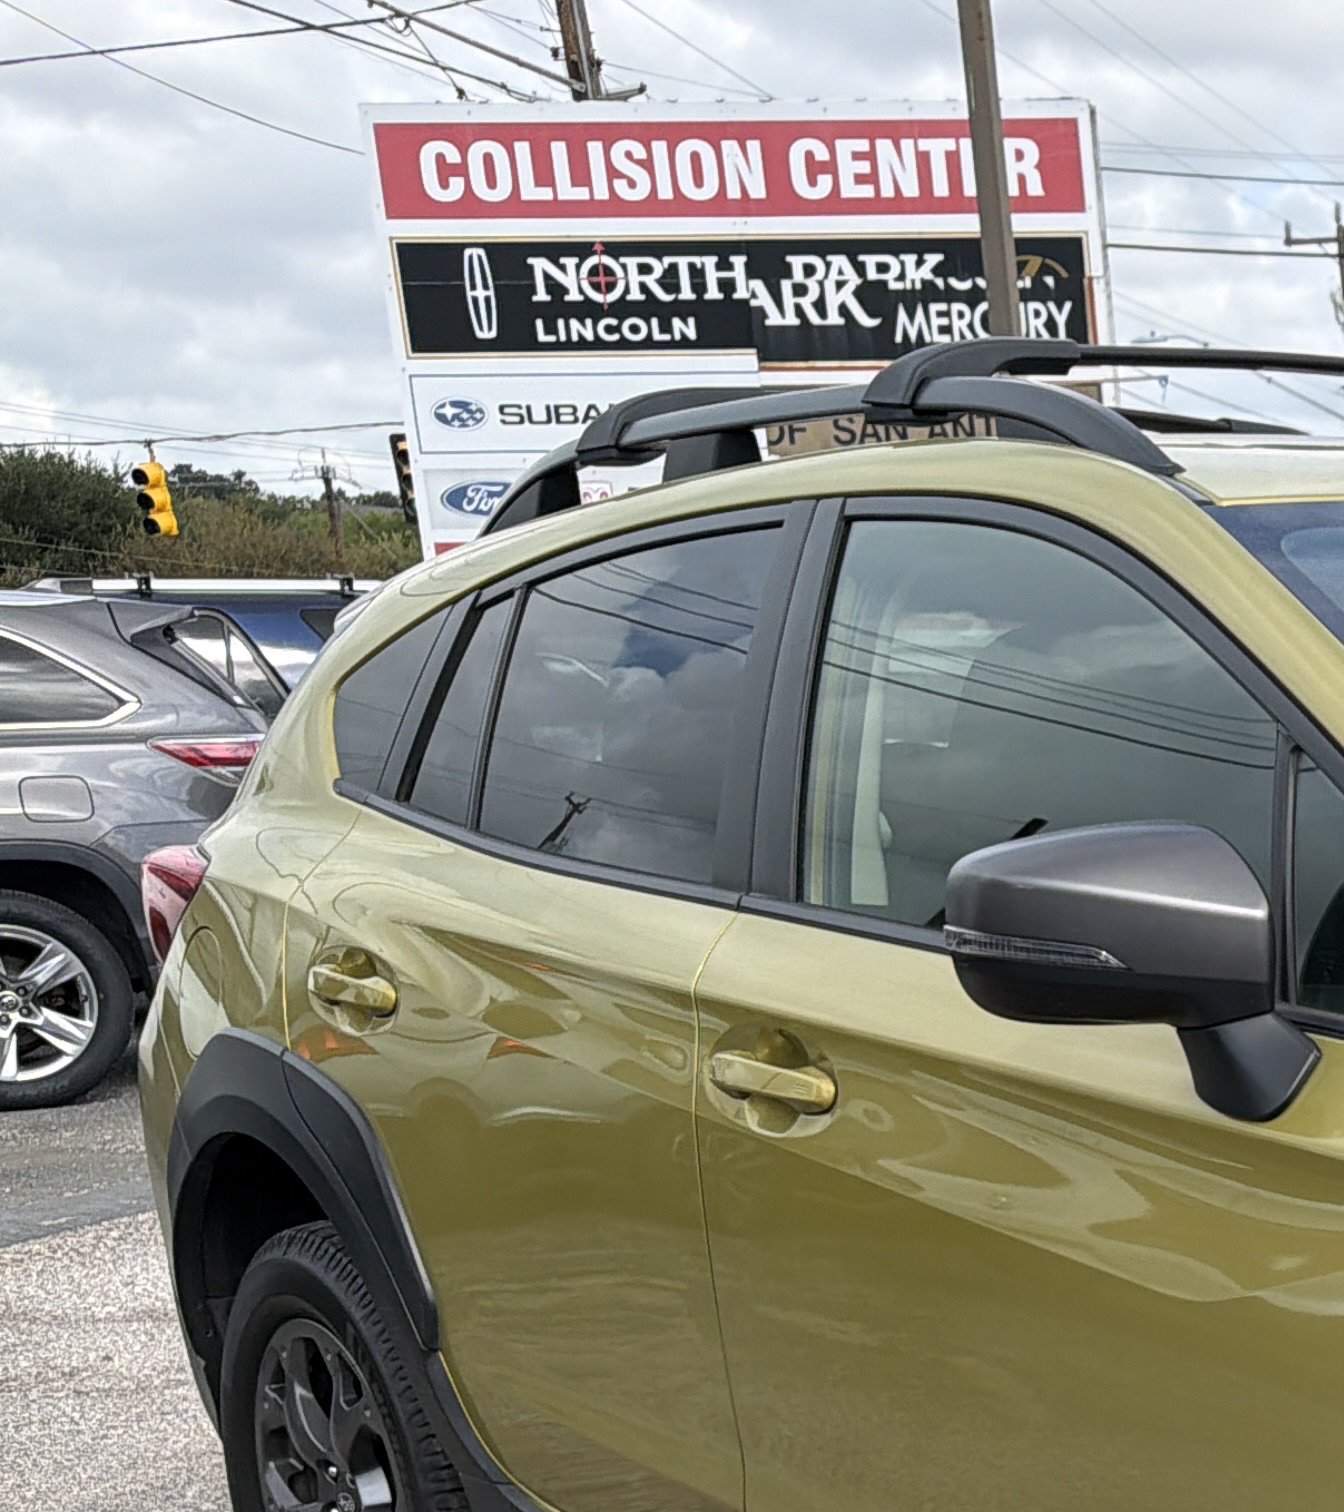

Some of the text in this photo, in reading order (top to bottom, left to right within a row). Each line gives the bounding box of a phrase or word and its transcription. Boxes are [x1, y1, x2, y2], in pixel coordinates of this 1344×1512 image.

[420, 138, 768, 202] COLLISION
[526, 254, 751, 303] NORTH
[535, 316, 698, 343] LINCOLN
[498, 403, 603, 425] SUBA
